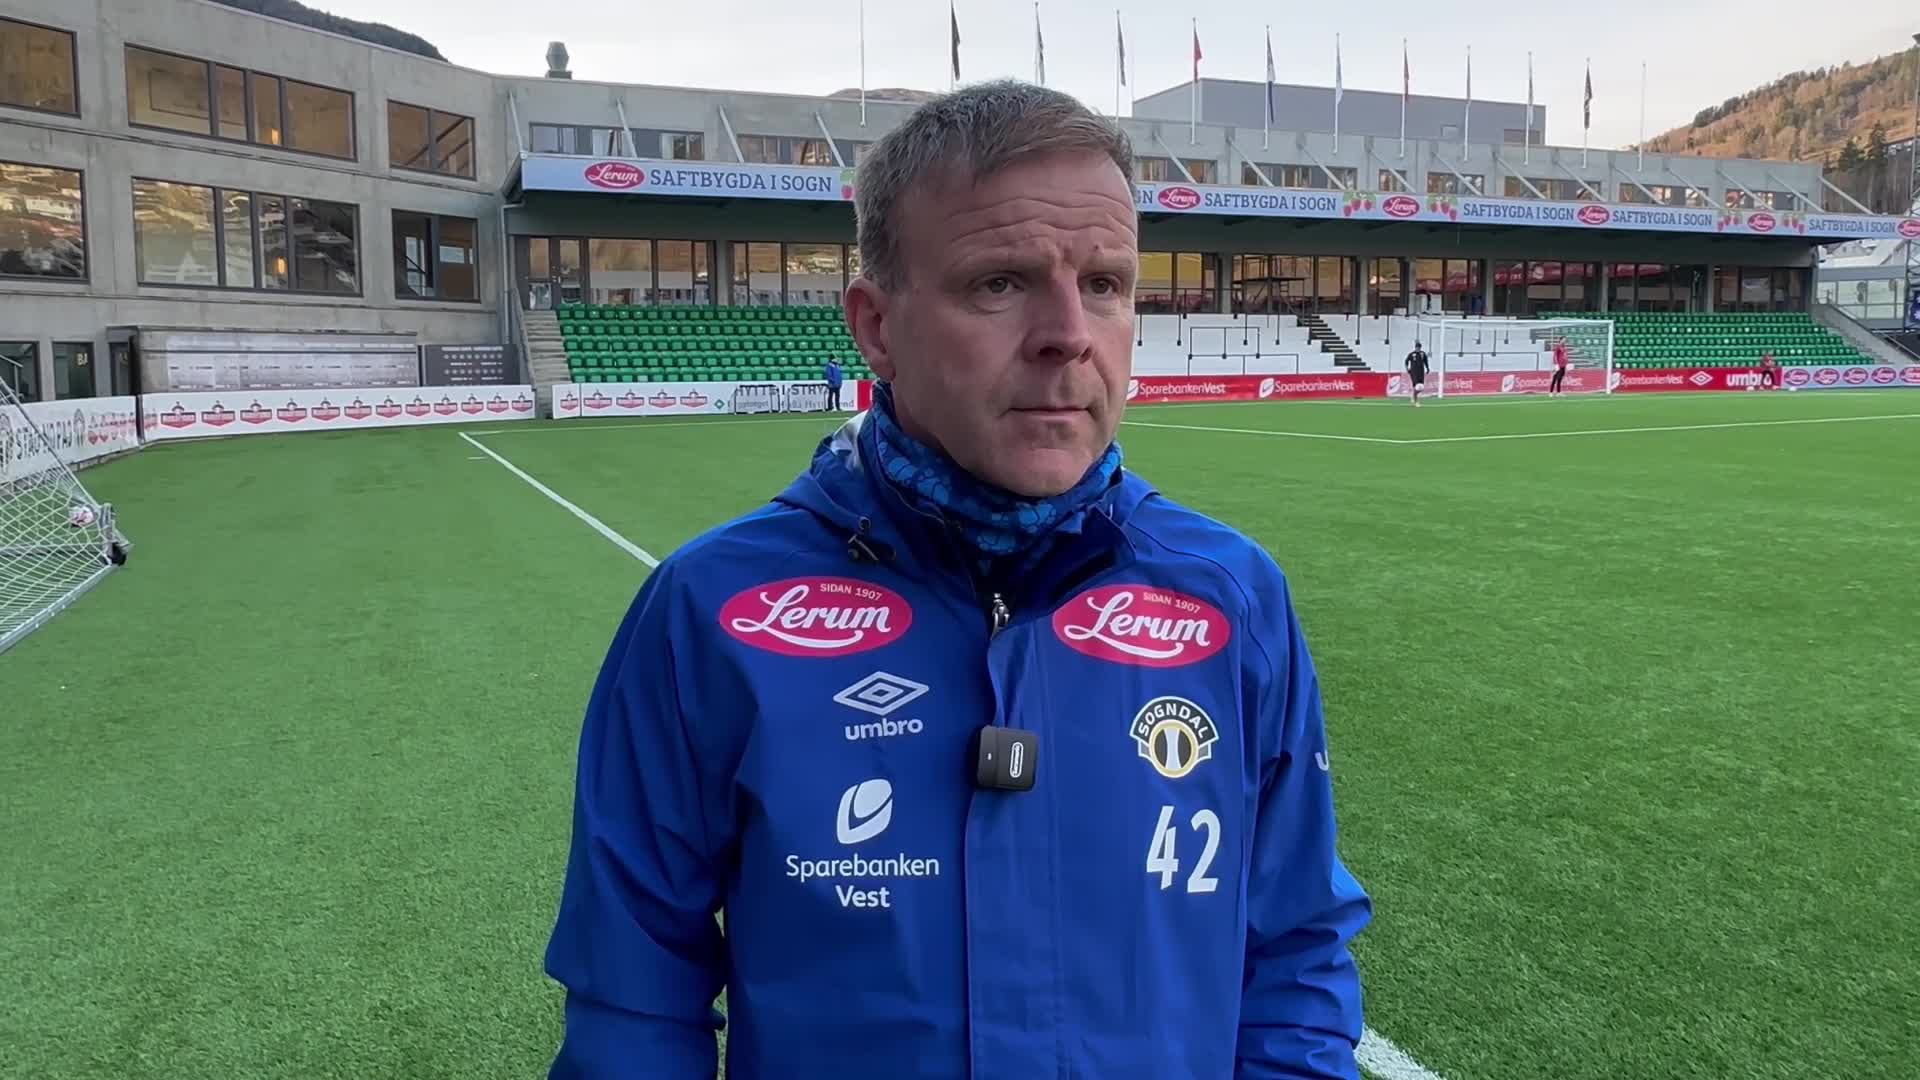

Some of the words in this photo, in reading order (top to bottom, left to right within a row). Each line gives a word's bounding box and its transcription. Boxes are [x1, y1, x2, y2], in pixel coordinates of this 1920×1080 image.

[587, 165, 639, 186] Lerum
[650, 168, 766, 190] SAFTBYGDA
[771, 174, 777, 190] I
[781, 175, 832, 192] SOGN
[1204, 192, 1289, 209] SAFTBYGDA
[1291, 197, 1297, 210] I
[1299, 197, 1336, 211] SOGN
[1463, 203, 1533, 219] SAFTBYGDA
[1535, 206, 1541, 219] I
[1543, 206, 1574, 220] SOGN
[1612, 210, 1677, 225] SAFTBYGDA
[1683, 213, 1712, 226] SOGN
[1870, 221, 1896, 233] SOGN
[820, 583, 852, 594] SIDAN
[855, 588, 882, 600] 1907
[1143, 591, 1172, 605] SIDAN
[1175, 599, 1201, 613] 1907
[731, 585, 891, 648] Lerum
[1064, 591, 1211, 659] Lerum
[845, 718, 924, 740] umbro
[1138, 702, 1208, 739] SOGNDAL
[1146, 805, 1221, 893] 42
[785, 853, 940, 883] Sparebanken
[835, 884, 891, 908] Vest
